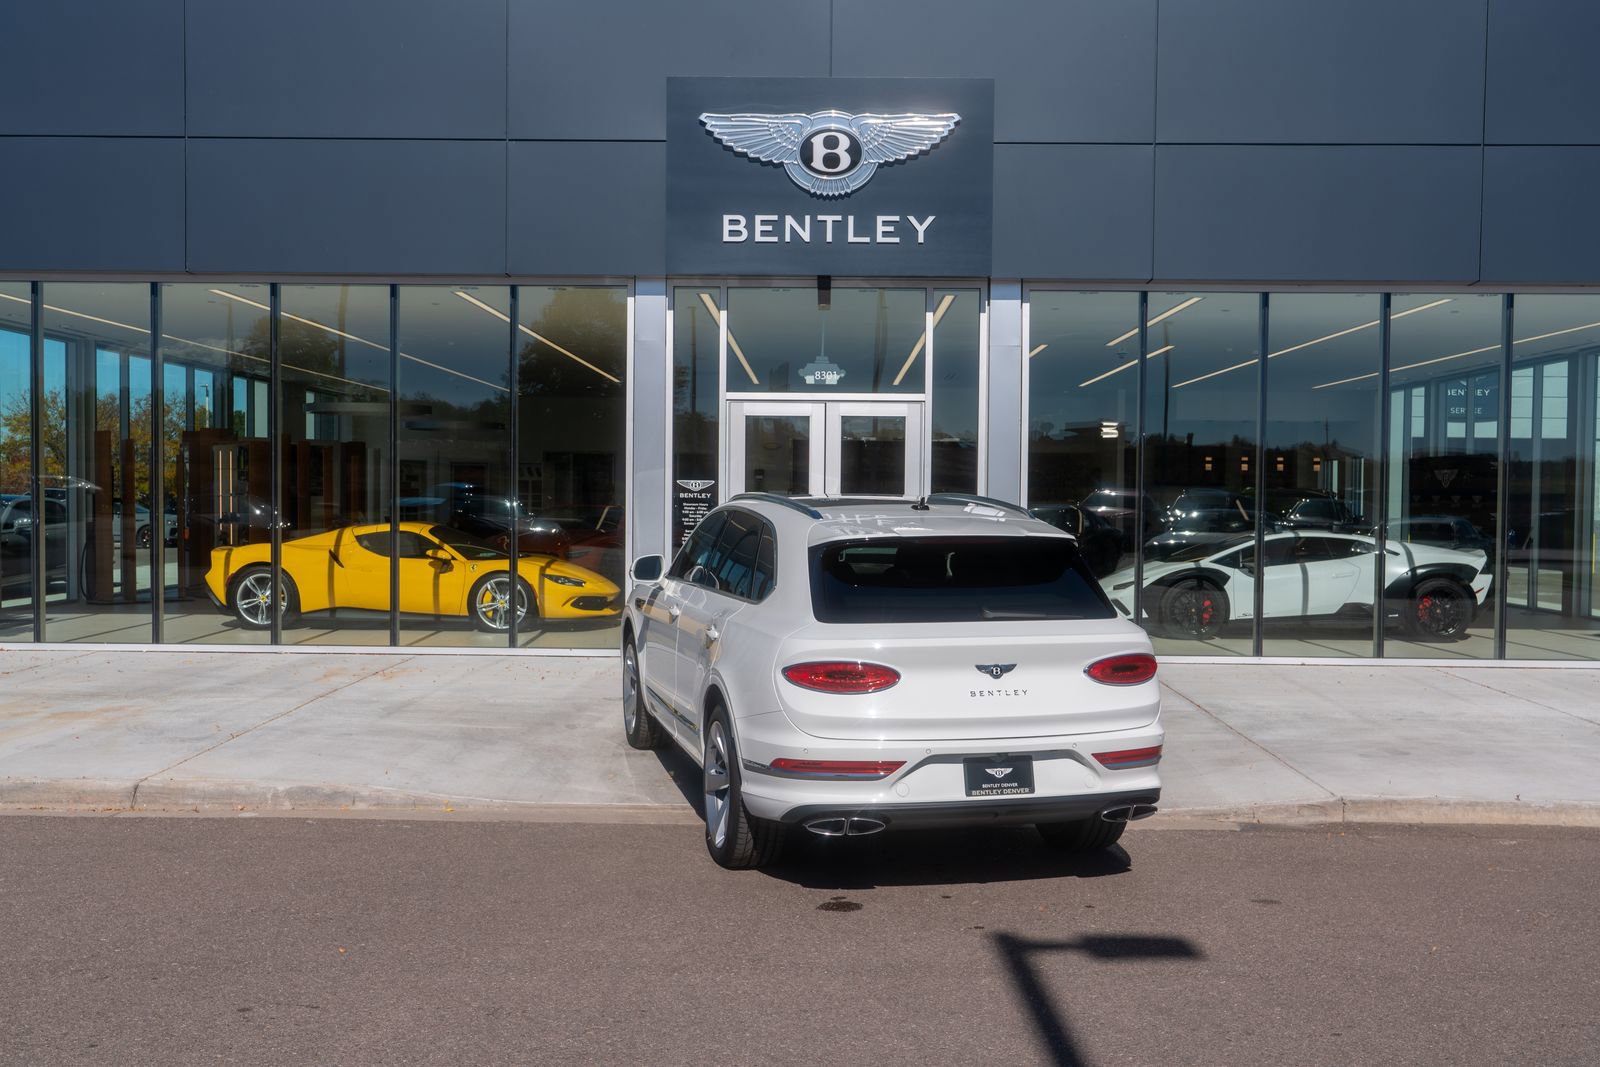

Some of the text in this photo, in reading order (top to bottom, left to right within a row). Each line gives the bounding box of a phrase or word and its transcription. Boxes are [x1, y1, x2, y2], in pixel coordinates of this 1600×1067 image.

[810, 131, 852, 173] B
[722, 214, 936, 244] BENTLEY
[814, 370, 837, 380] 8301
[970, 689, 1028, 698] BENTLEY
